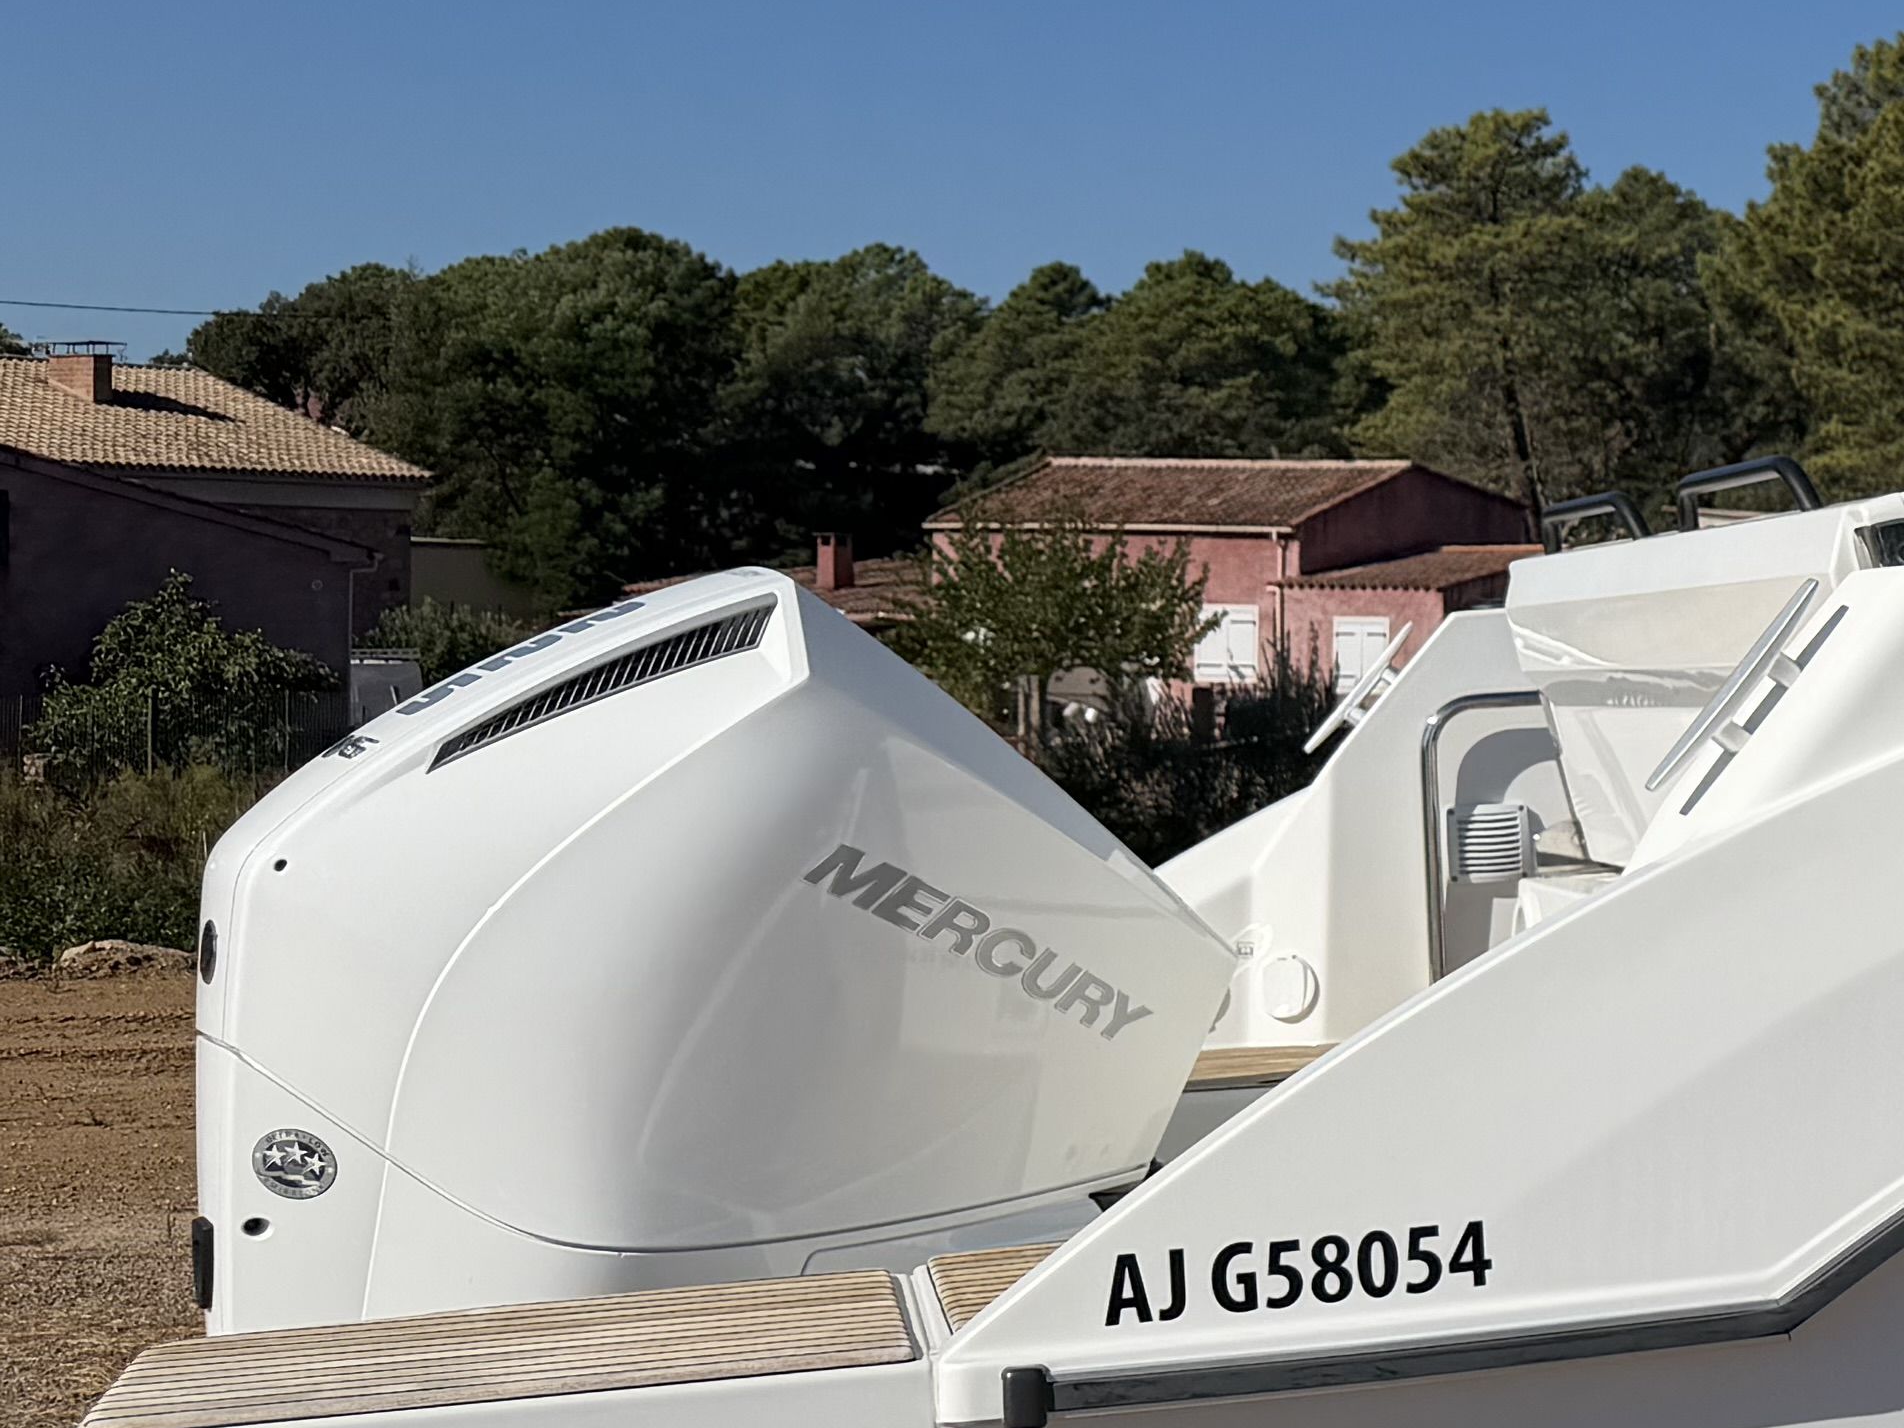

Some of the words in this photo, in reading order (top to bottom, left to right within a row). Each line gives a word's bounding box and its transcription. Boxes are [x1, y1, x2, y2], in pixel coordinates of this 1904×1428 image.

[801, 843, 1154, 1041] MERCURY
[1104, 1247, 1187, 1327] AJ
[1211, 1219, 1493, 1313] G58054
